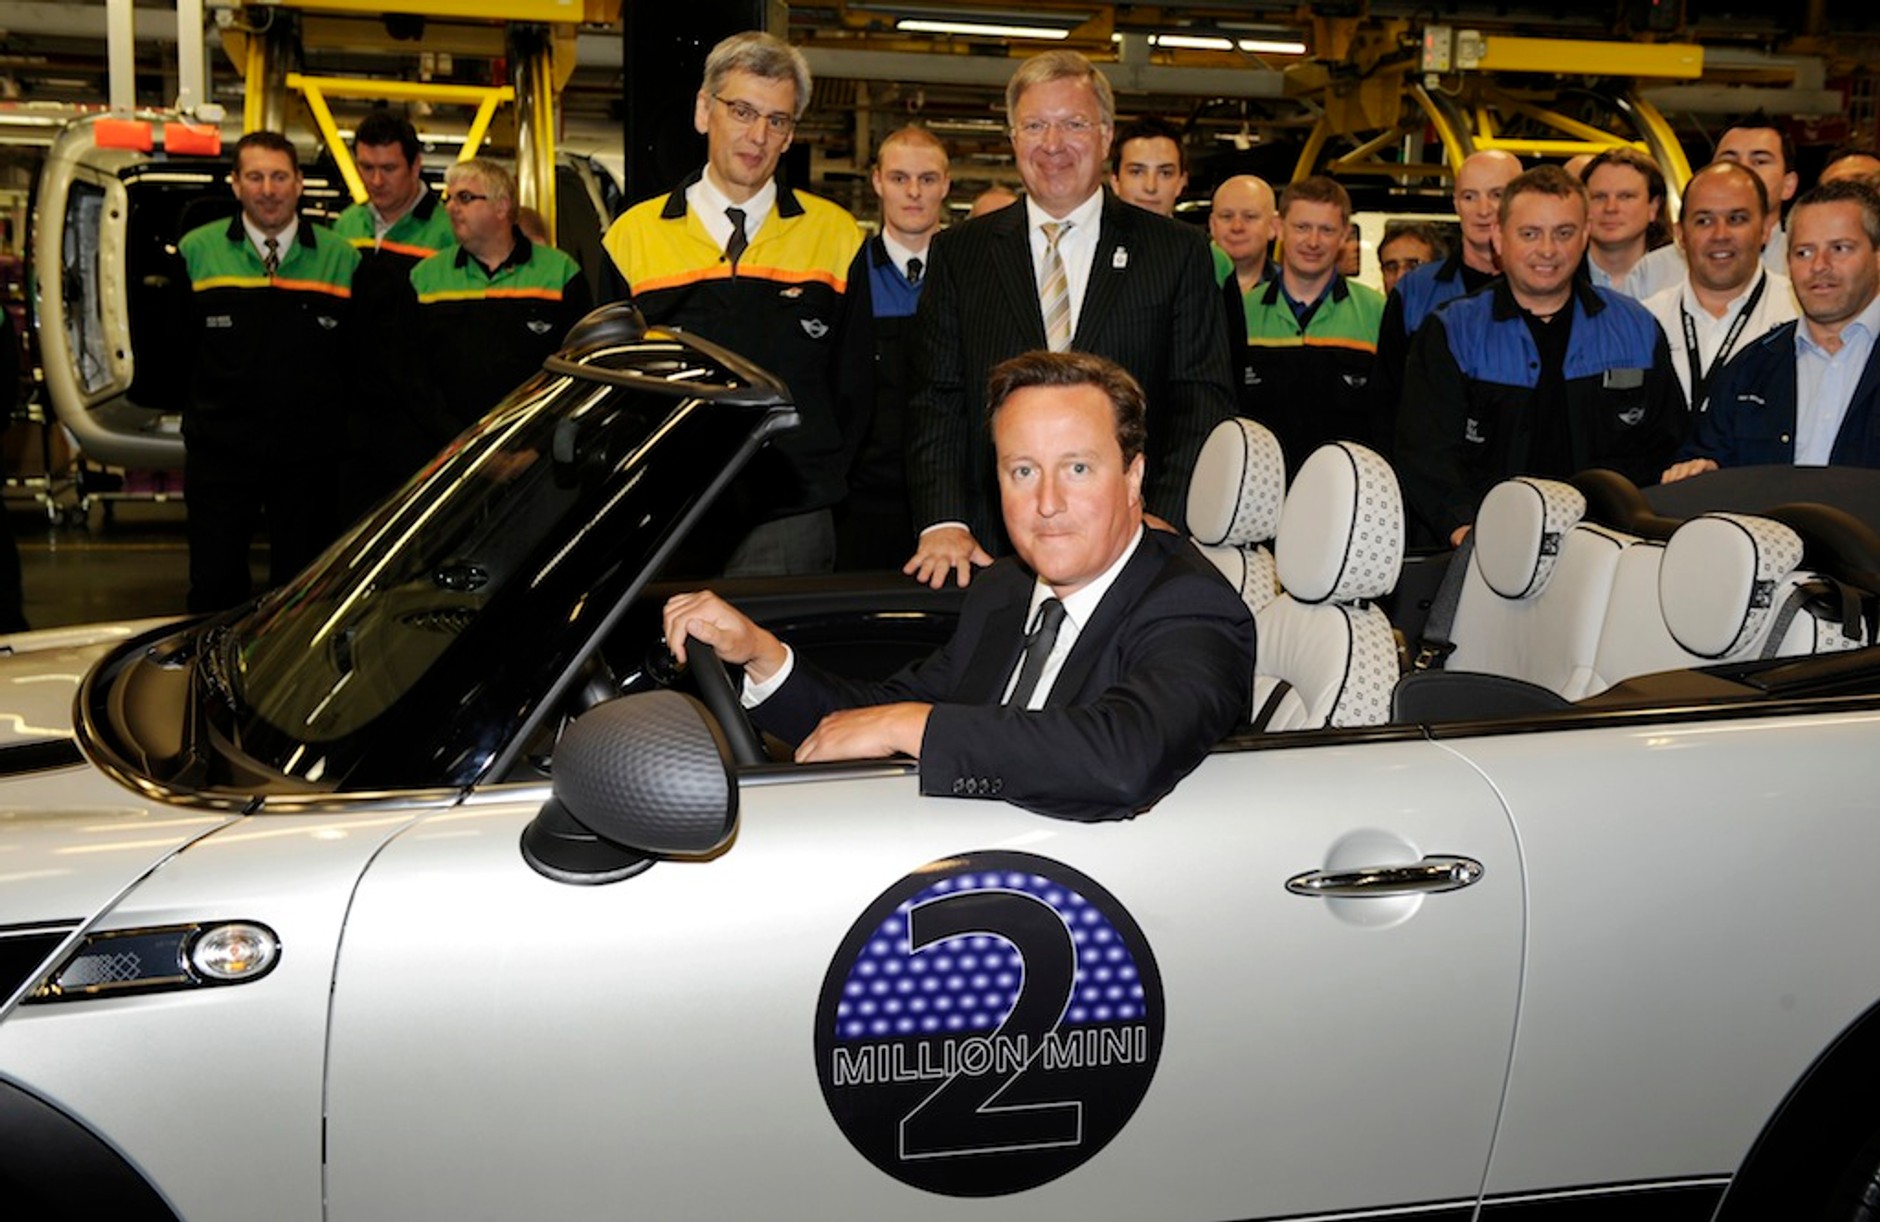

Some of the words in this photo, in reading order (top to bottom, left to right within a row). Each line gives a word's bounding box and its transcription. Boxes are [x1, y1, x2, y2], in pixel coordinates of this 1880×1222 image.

[833, 1035, 1028, 1085] MILLION
[1043, 1026, 1147, 1071] MINI
[900, 888, 1082, 1159] 2
